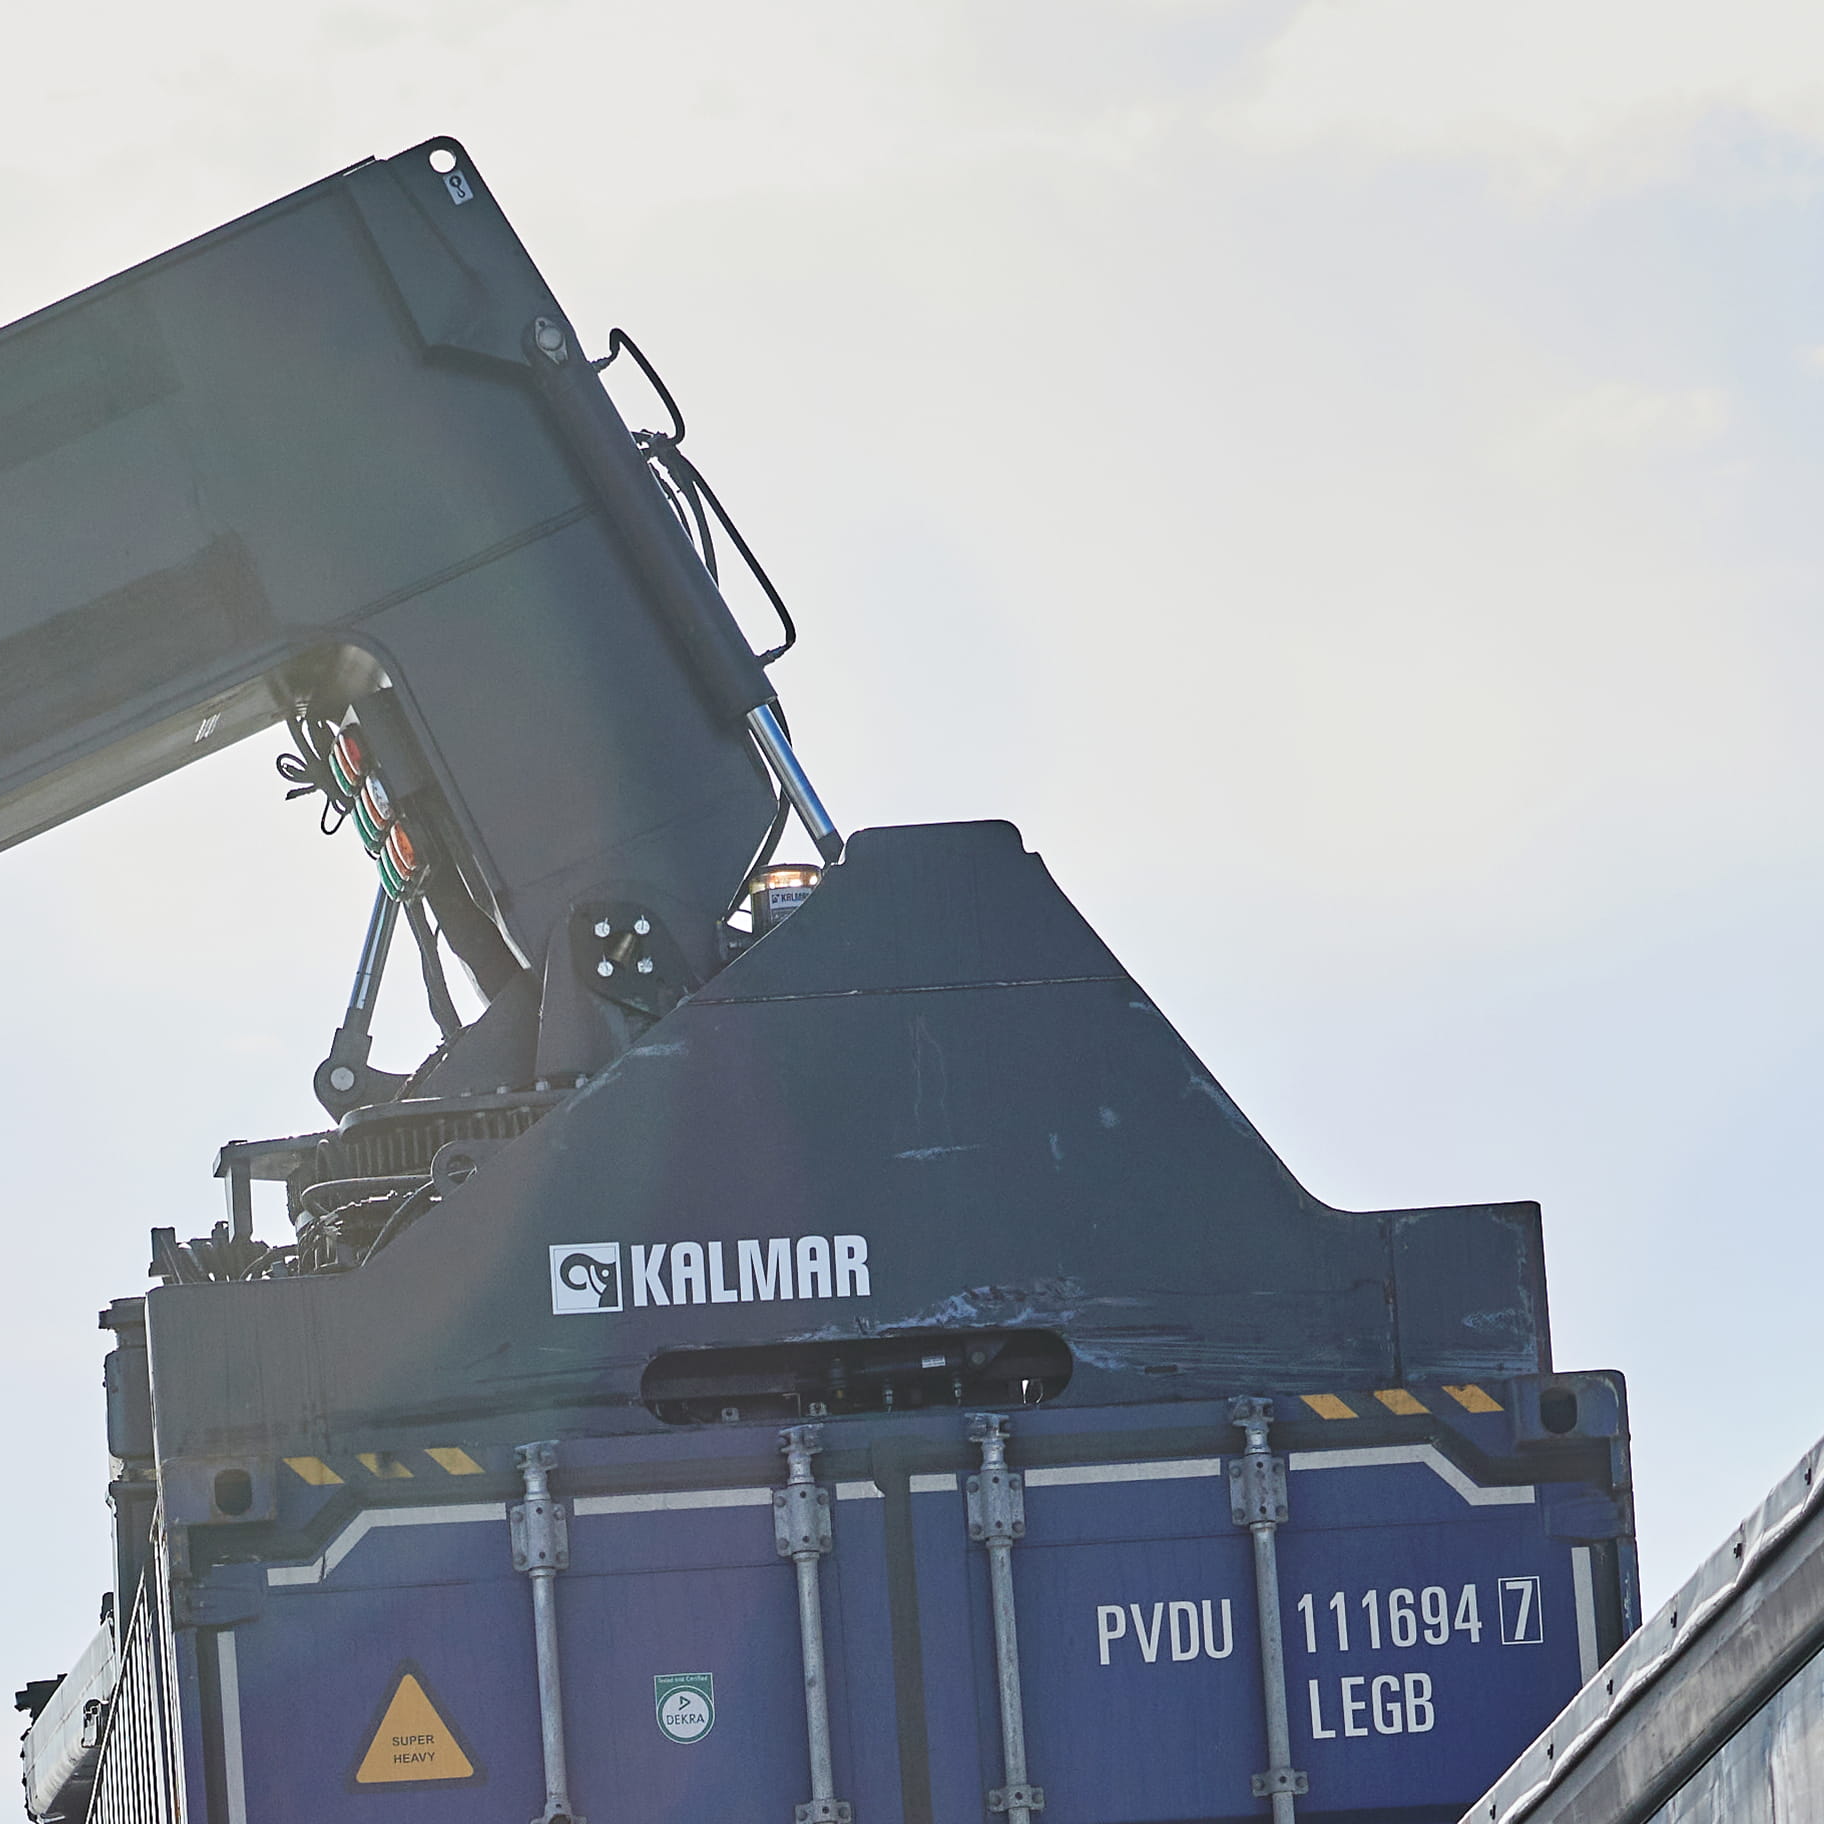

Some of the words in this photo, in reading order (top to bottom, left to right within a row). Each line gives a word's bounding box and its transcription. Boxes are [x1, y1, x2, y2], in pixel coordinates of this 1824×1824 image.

[631, 1235, 870, 1307] KALMAR
[1096, 1598, 1233, 1665] PVDU
[1297, 1583, 1482, 1653] 111694
[1504, 1580, 1534, 1640] 7
[666, 1713, 705, 1725] DEKRA
[1308, 1672, 1435, 1739] LEGB
[392, 1735, 434, 1746] SUPER
[393, 1752, 435, 1764] HEAVY
